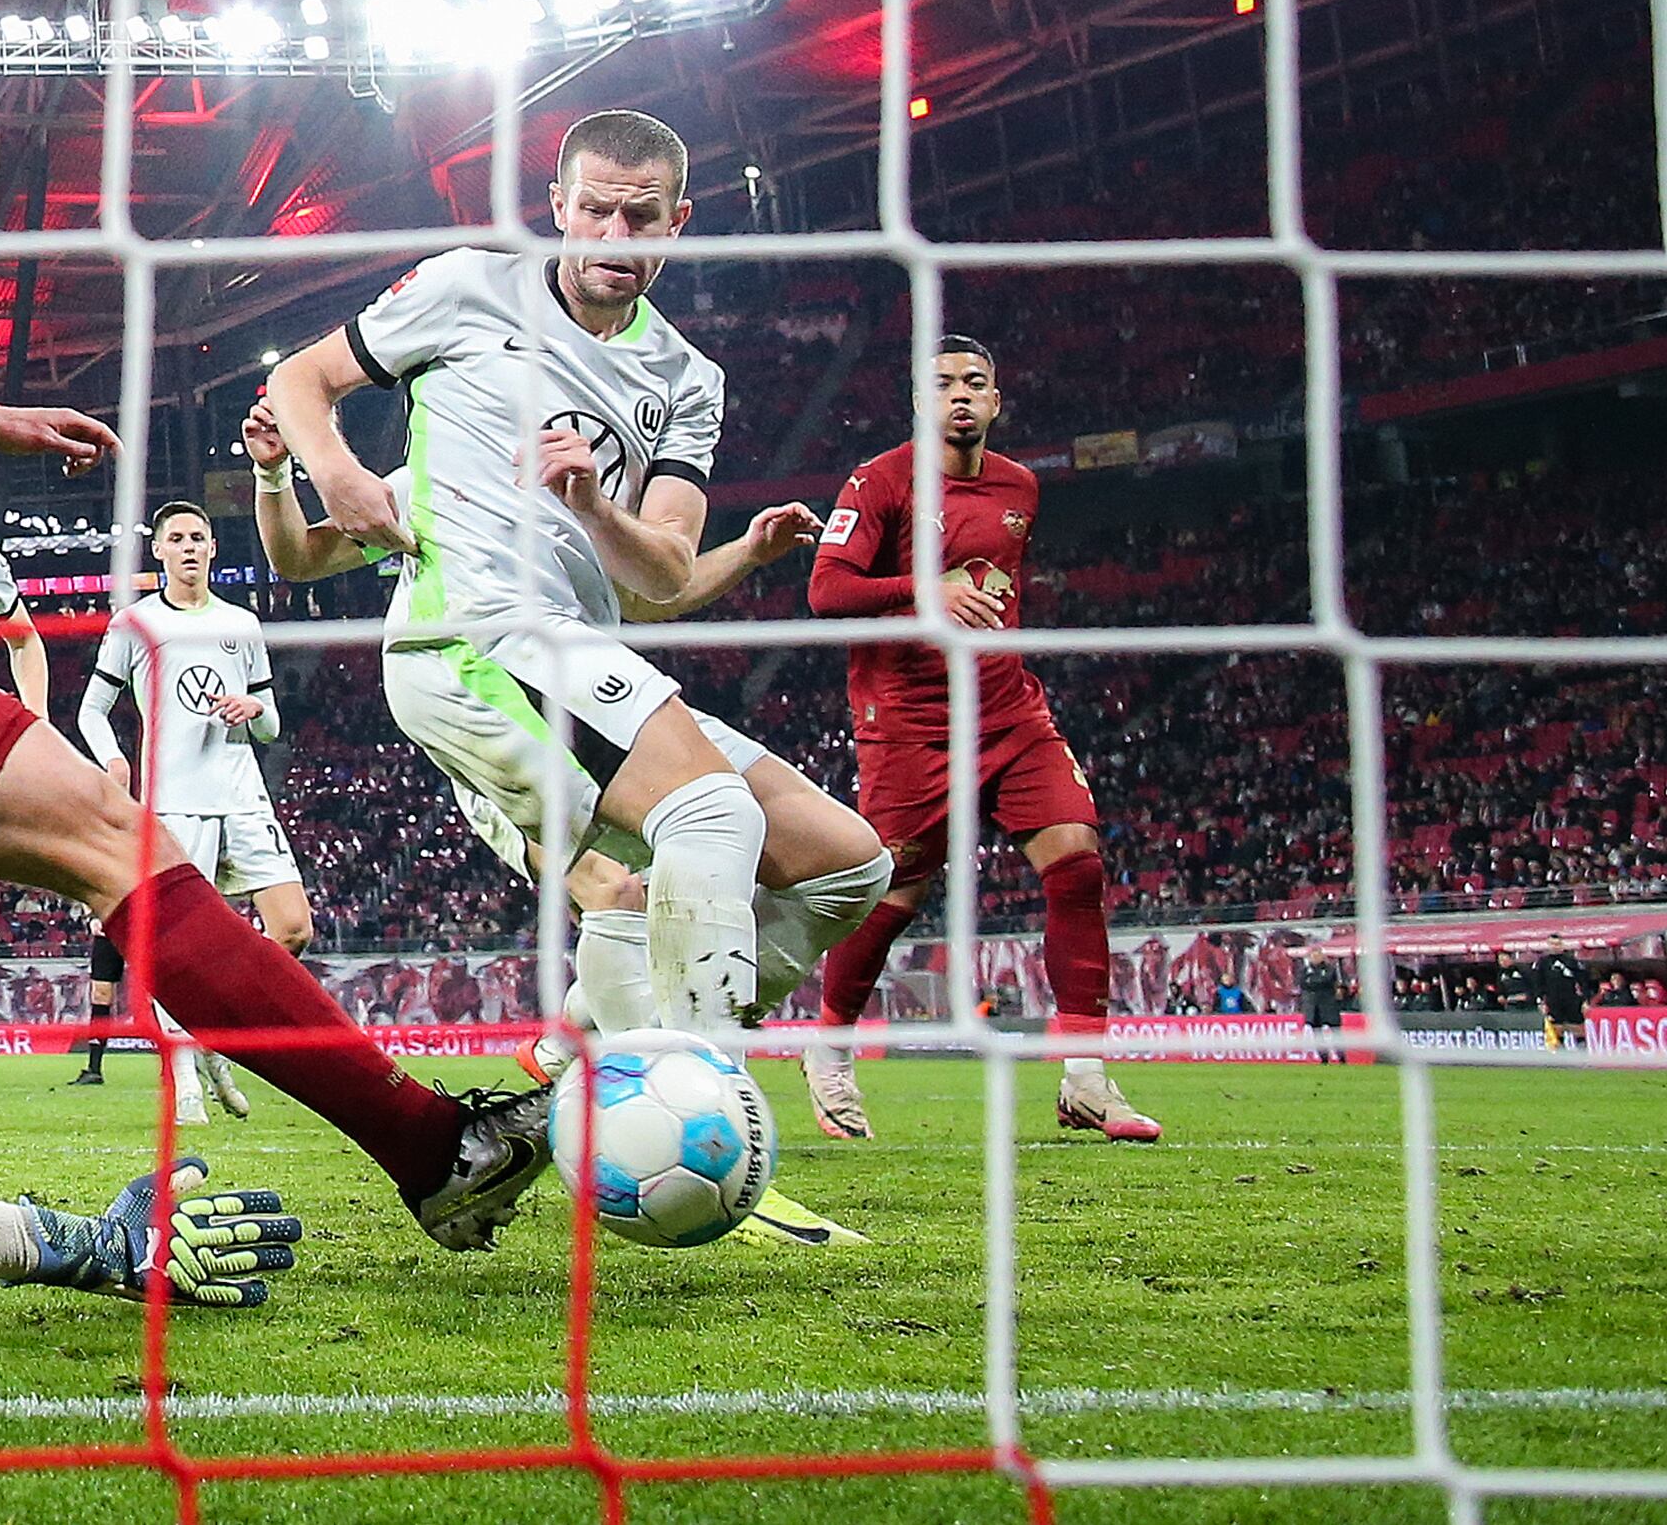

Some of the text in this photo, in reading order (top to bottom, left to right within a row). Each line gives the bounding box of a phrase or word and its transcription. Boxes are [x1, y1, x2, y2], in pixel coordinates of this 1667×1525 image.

[1466, 1025, 1496, 1051] FÜR
[1499, 1029, 1546, 1051] DEINE
[733, 1089, 763, 1209] DERBYSTAR
